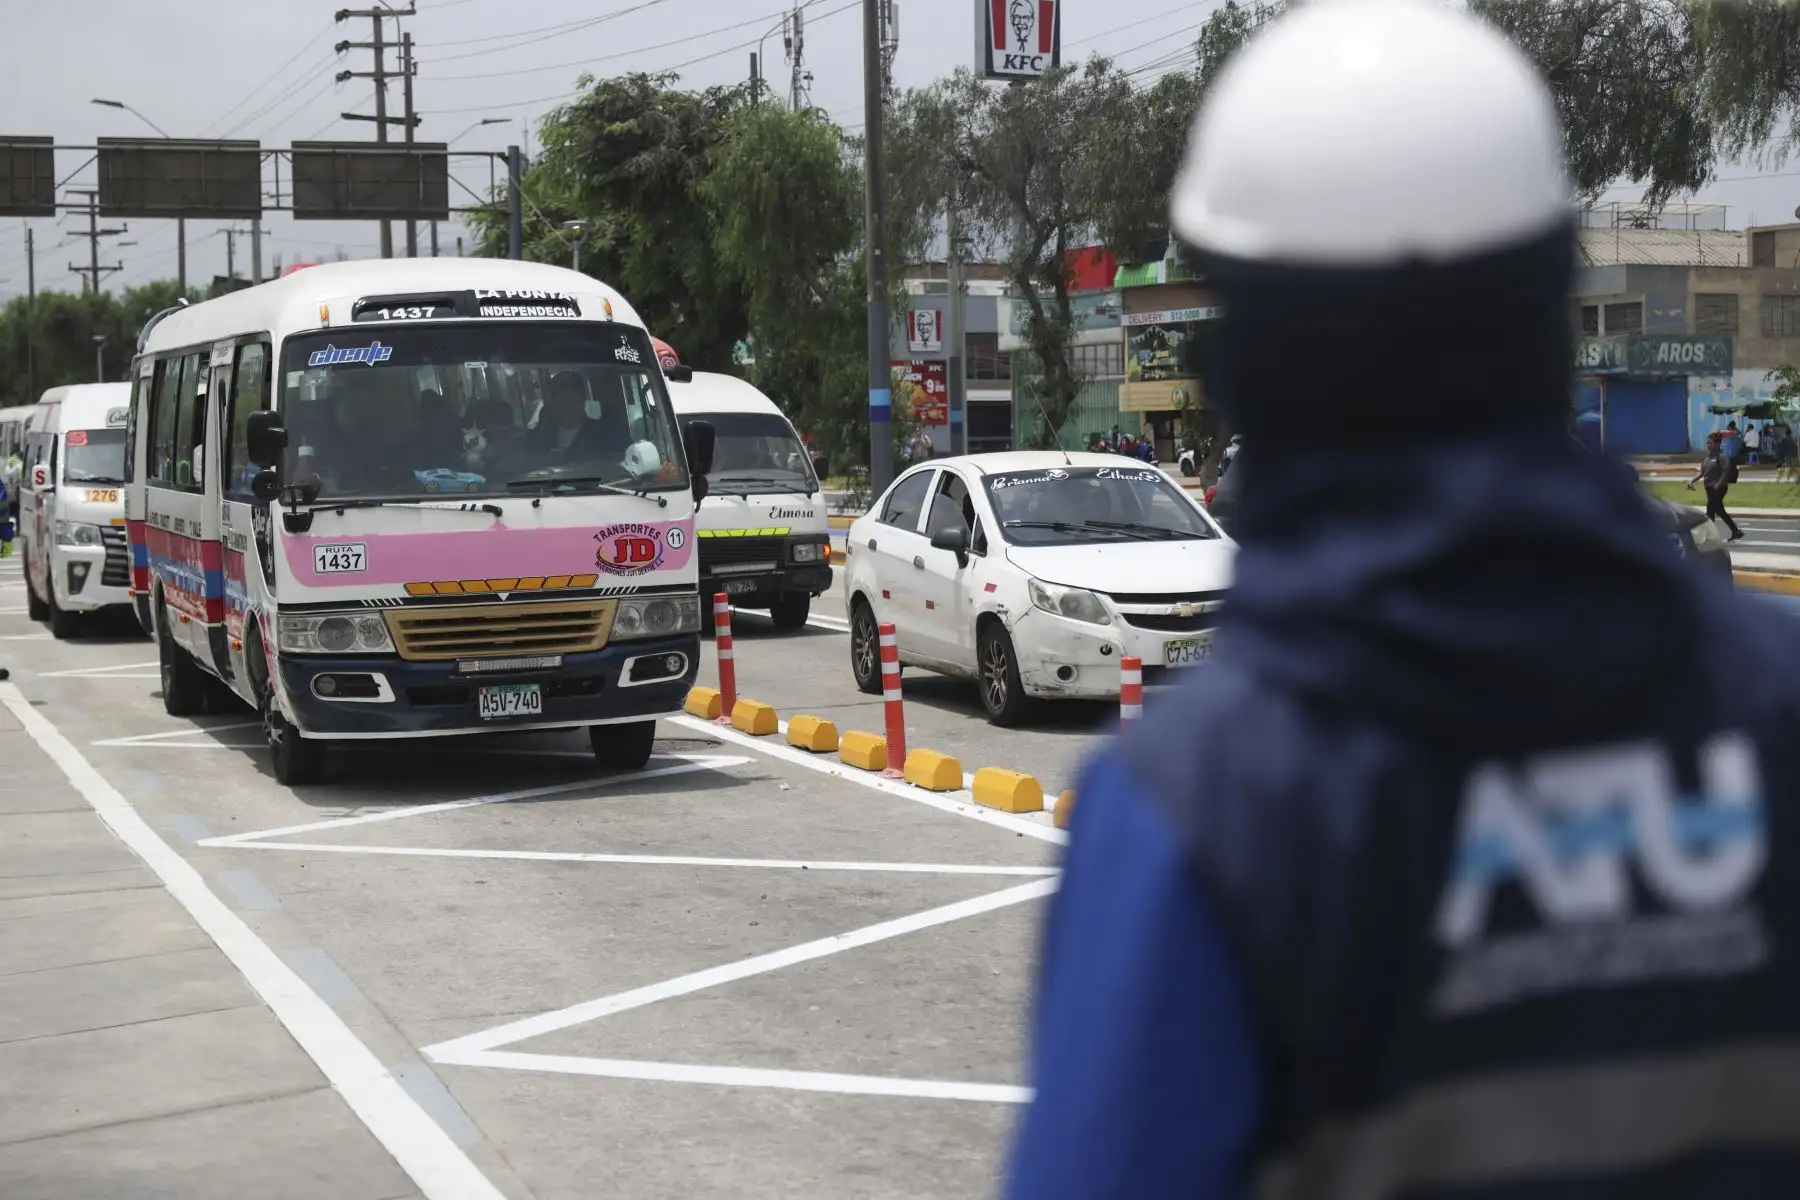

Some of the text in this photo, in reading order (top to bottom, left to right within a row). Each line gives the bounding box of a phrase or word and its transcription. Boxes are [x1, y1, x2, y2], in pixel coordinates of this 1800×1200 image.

[1003, 54, 1043, 71] KFC
[474, 288, 574, 301] LA PUNTA
[378, 307, 436, 320] 1437
[480, 306, 577, 317] INDEPENDECIA
[1657, 342, 1704, 363] AROS
[35, 470, 45, 485] S
[1096, 468, 1143, 482] Ethan
[991, 476, 1050, 490] Brianna
[593, 523, 661, 543] TRANSPORTES
[669, 532, 681, 545] 11
[613, 538, 656, 563] JD
[318, 553, 362, 570] 1437
[499, 685, 520, 694] PERU
[482, 691, 540, 713] A5V-740
[1434, 730, 1769, 948] ATU
